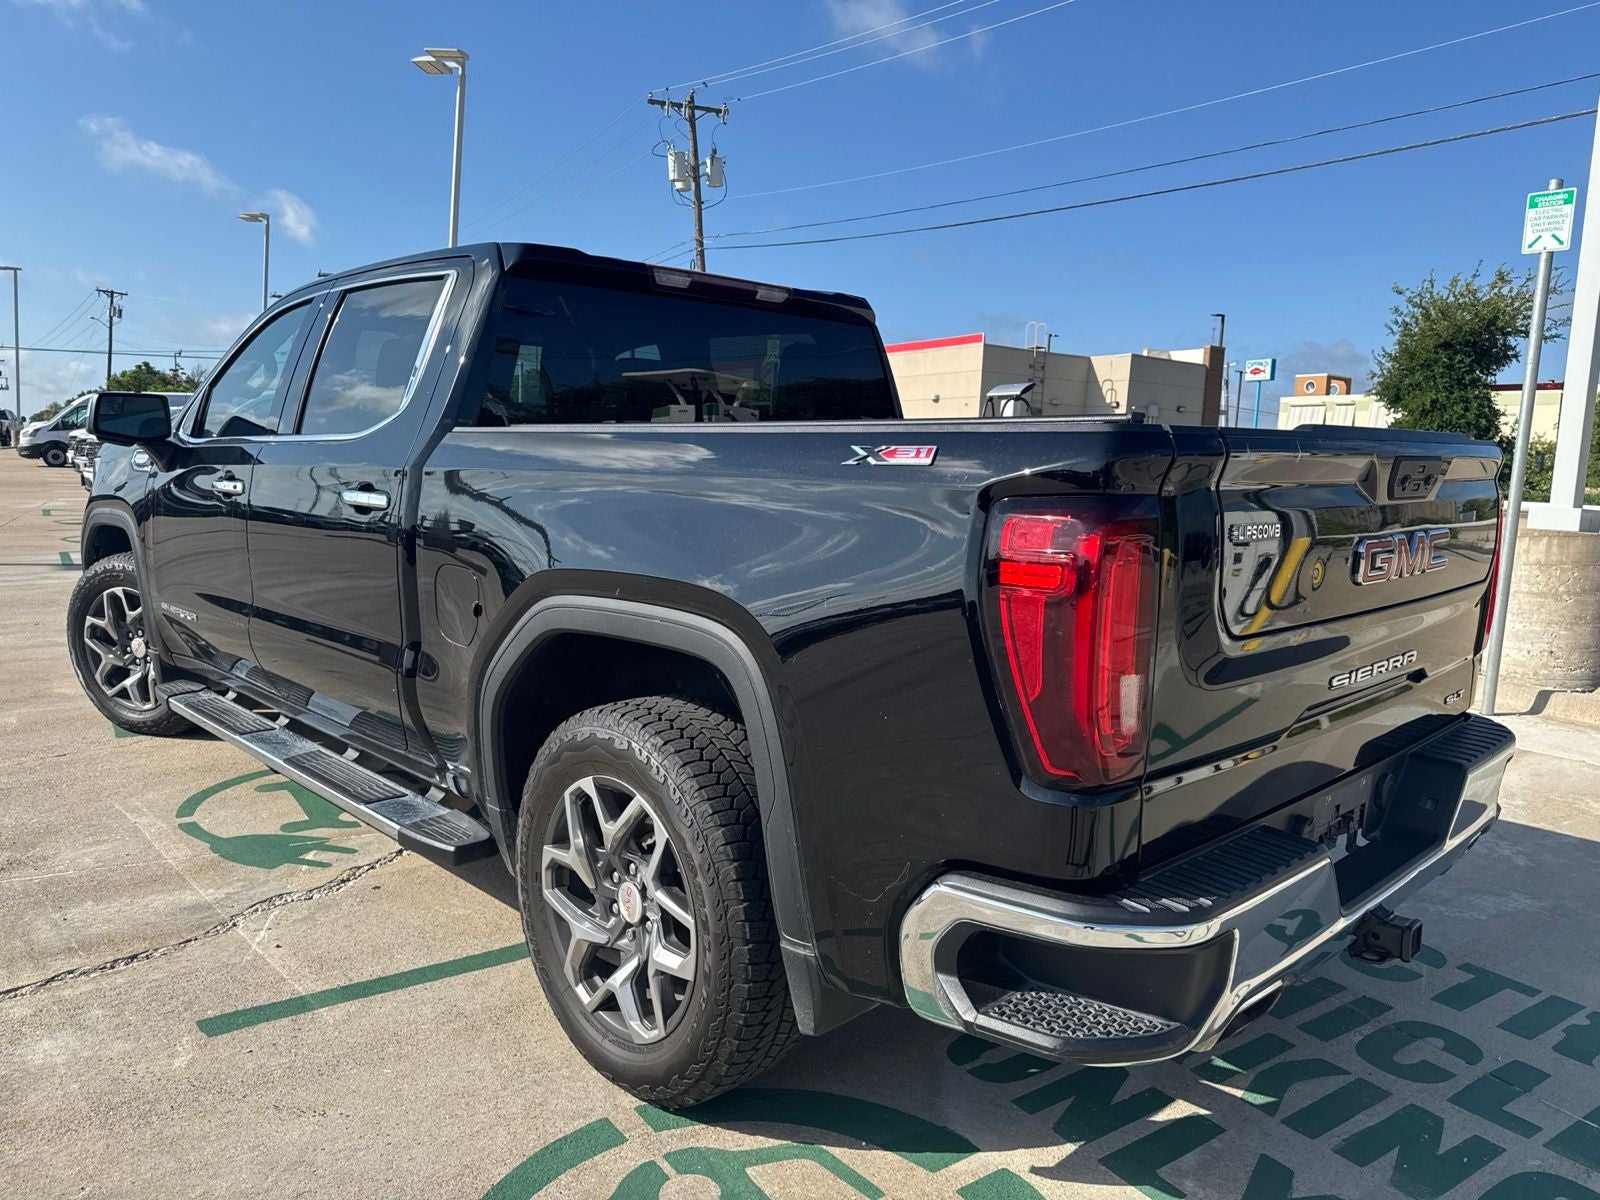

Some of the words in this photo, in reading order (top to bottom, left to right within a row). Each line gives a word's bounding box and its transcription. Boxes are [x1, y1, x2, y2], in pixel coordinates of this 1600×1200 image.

[1535, 194, 1568, 203] CHARGING
[1538, 200, 1564, 208] STATION
[1535, 207, 1564, 215] ELECTRIC
[1548, 219, 1566, 227] WHILE
[1532, 226, 1563, 234] CHARGING
[1238, 523, 1281, 541] LIPSCOMB
[1349, 528, 1451, 586] GMC
[1328, 650, 1418, 691] SIERRA
[1443, 688, 1466, 705] SLT
